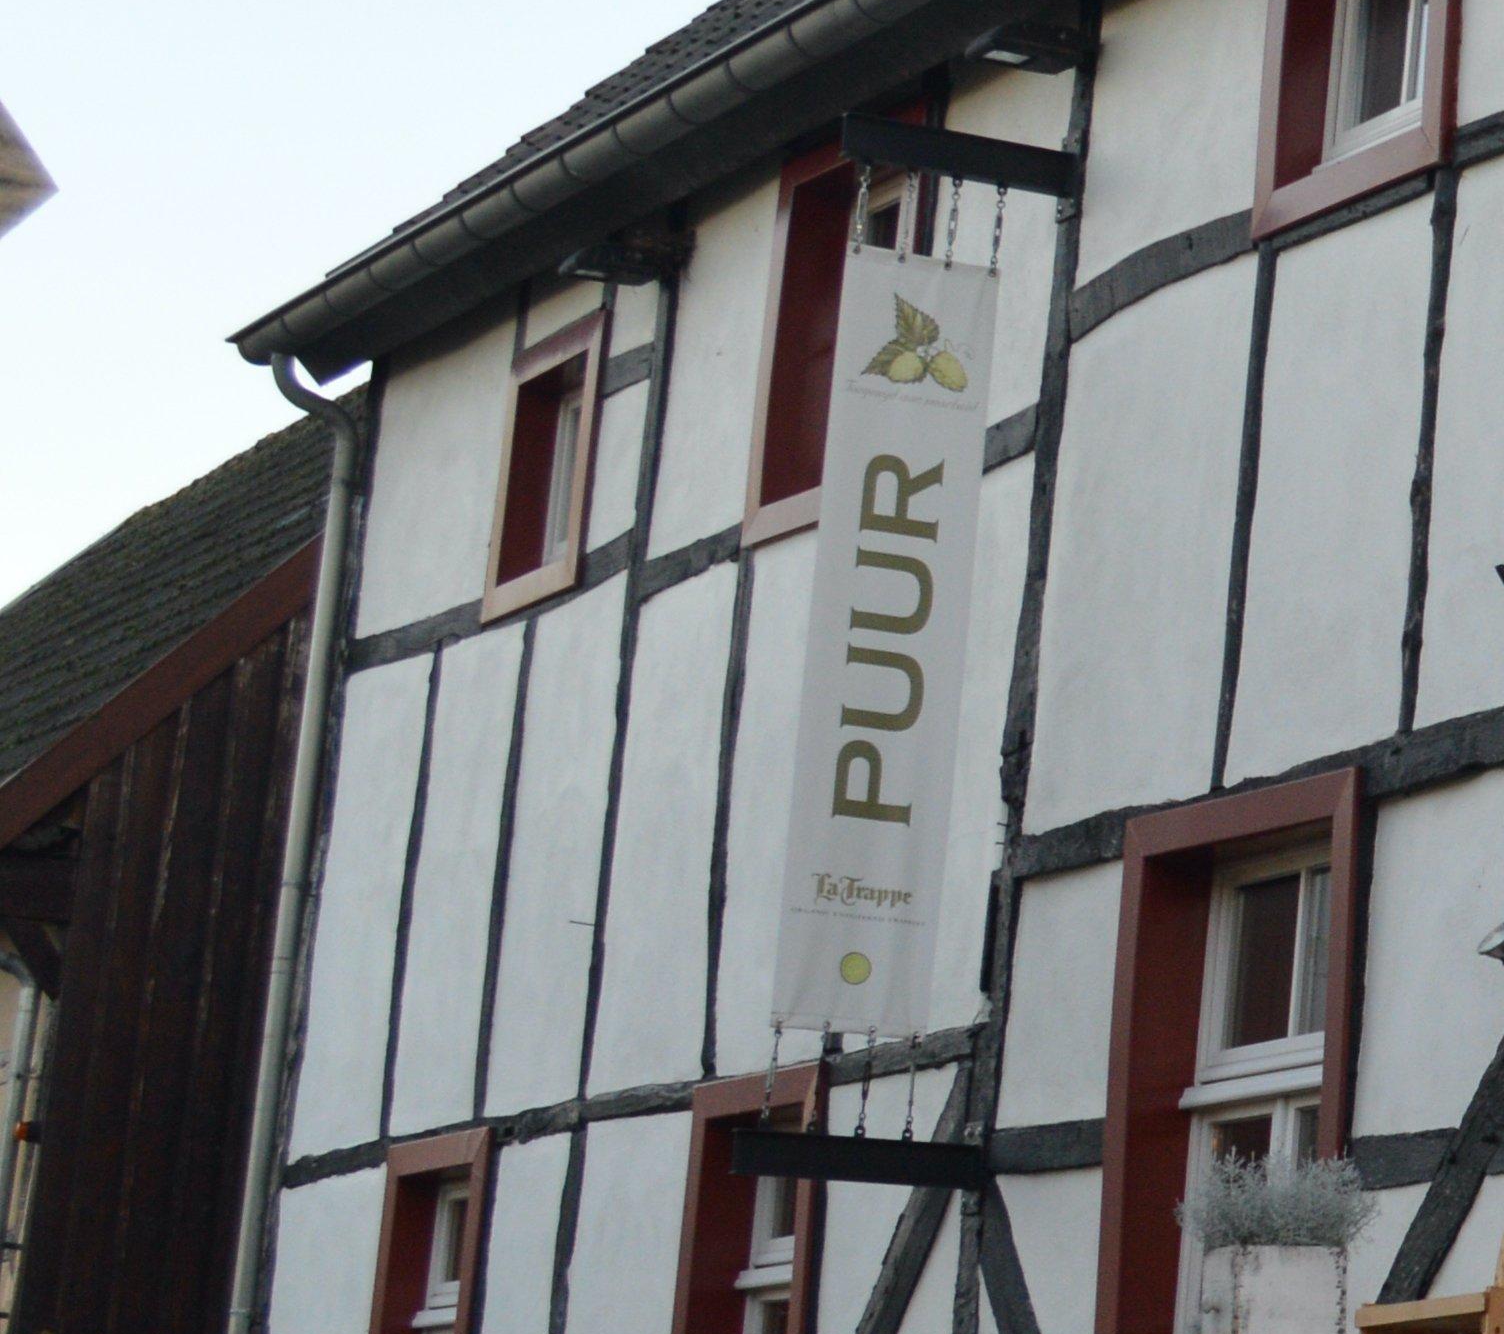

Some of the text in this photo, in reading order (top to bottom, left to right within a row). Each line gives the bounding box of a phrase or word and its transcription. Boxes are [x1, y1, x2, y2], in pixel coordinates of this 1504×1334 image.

[831, 453, 945, 828] PUUR
[811, 872, 913, 908] La Trappe
